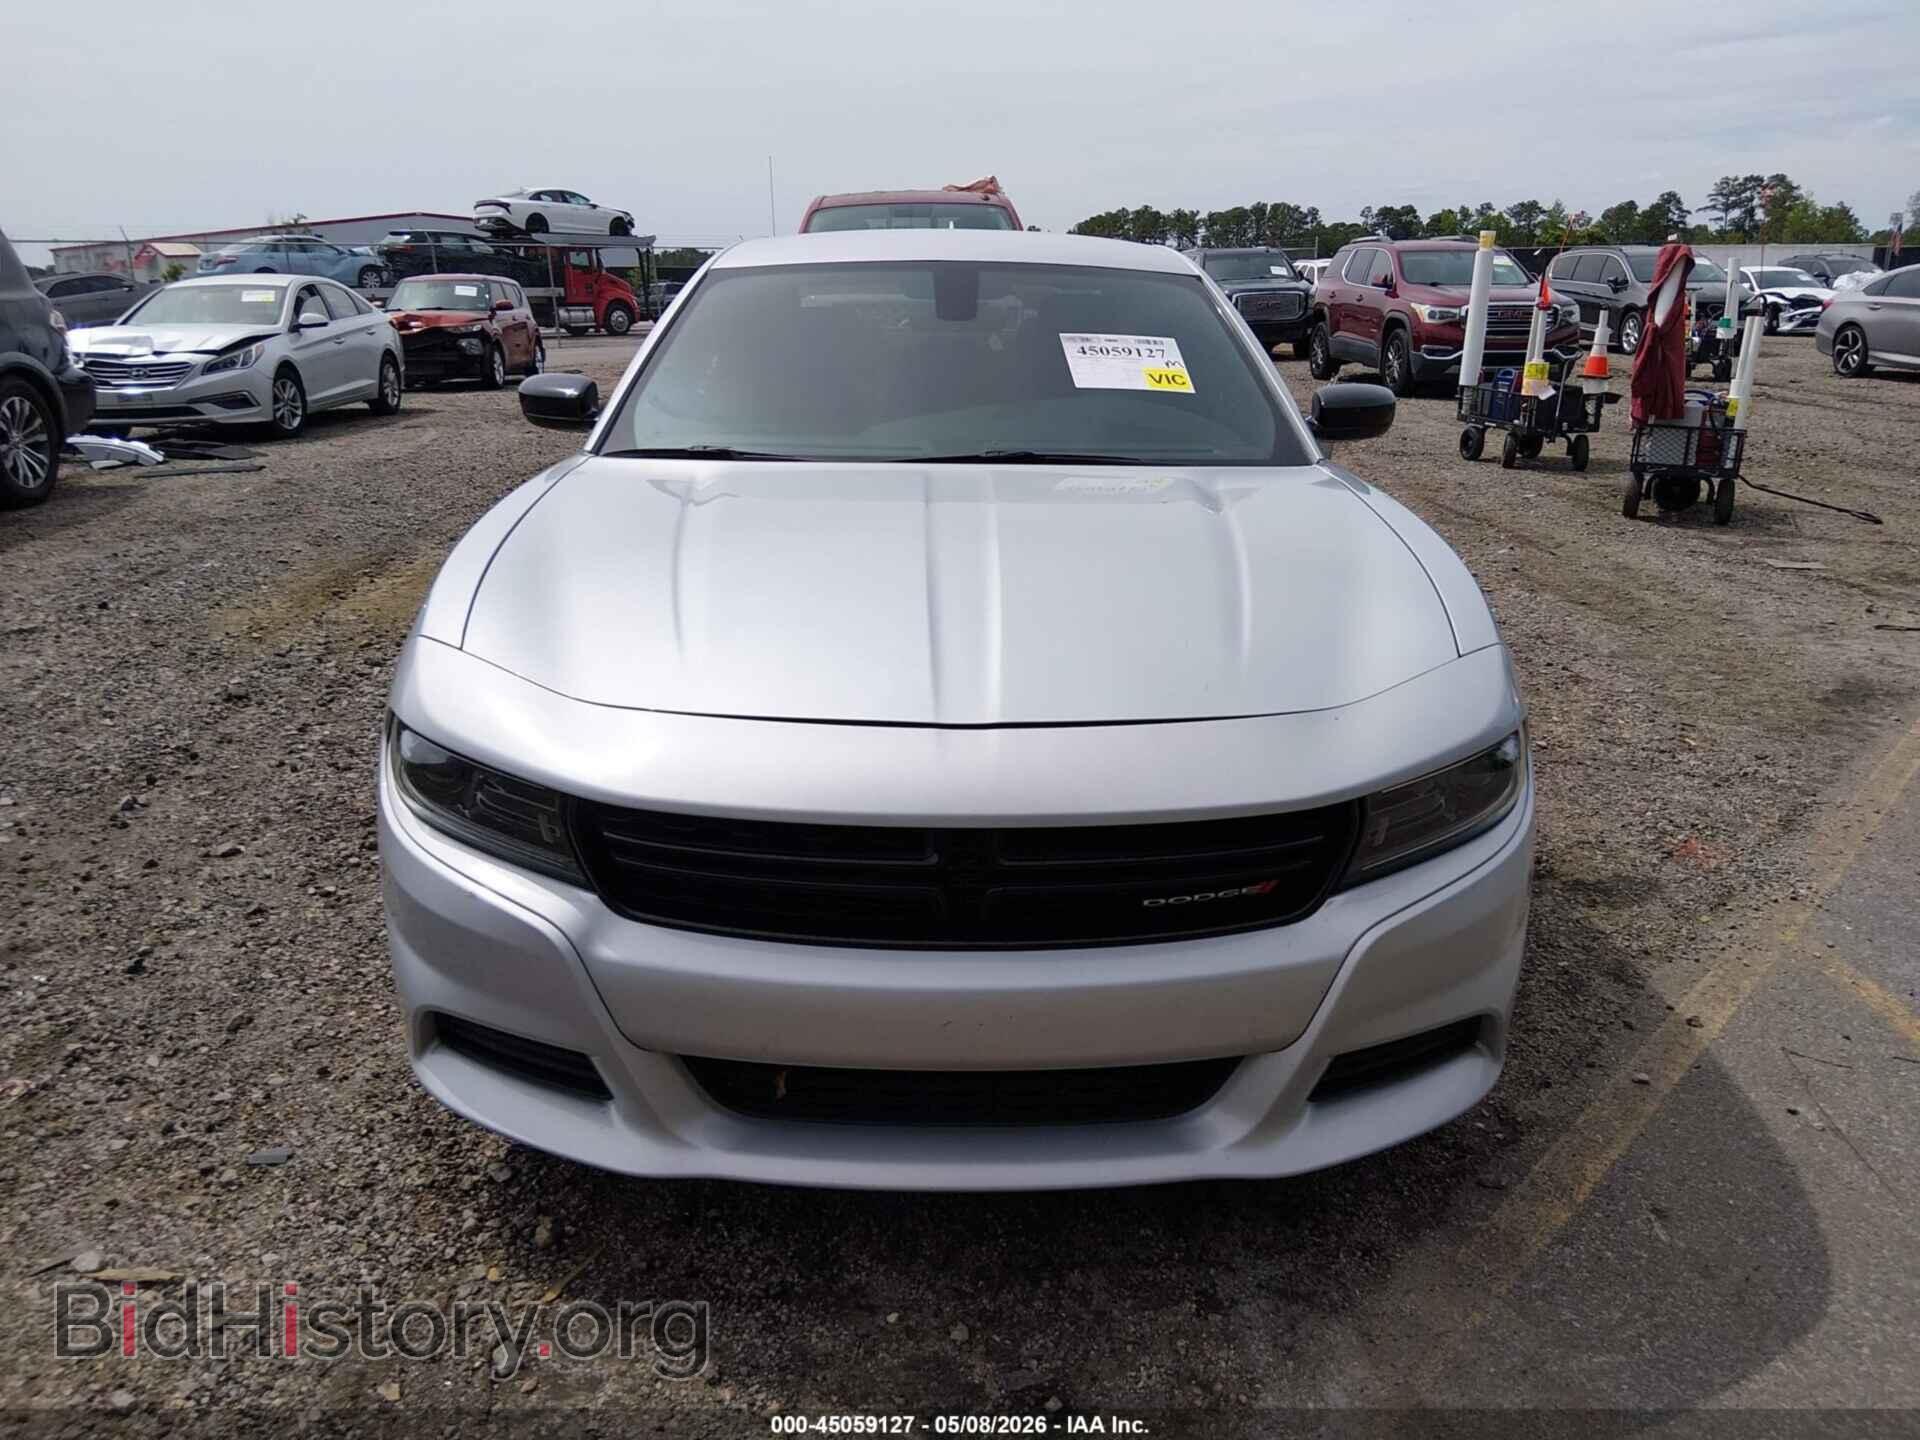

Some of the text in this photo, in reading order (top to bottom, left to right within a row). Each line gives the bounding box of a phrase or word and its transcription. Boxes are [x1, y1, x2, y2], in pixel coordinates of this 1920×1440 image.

[1077, 345, 1166, 359] 45059127
[1147, 373, 1187, 386] VIC
[1142, 884, 1258, 907] DODGE
